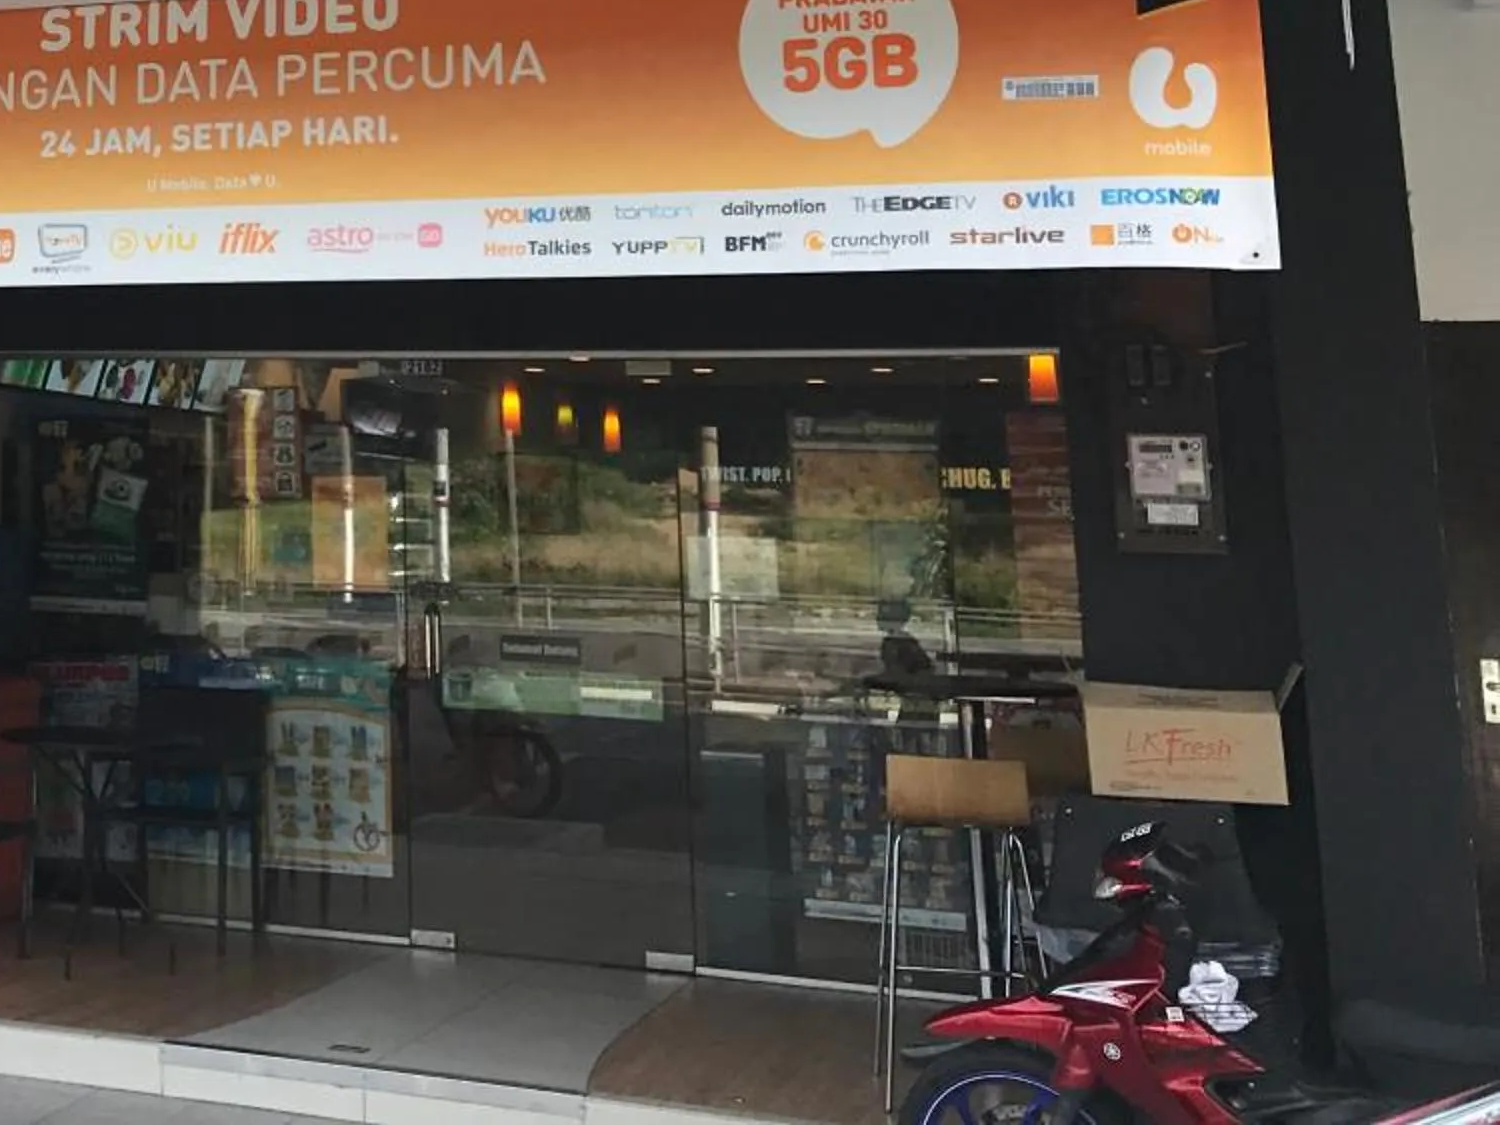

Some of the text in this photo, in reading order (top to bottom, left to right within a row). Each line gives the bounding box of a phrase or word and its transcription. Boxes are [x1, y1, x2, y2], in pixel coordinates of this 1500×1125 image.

[802, 8, 889, 34] UMI 30
[136, 57, 259, 105] DATA
[277, 39, 548, 97] PERCUMA
[781, 33, 920, 94] 5GB
[39, 114, 399, 159] 24 JAM, SETIAP HARI.
[1143, 137, 1213, 157] mobile
[721, 198, 827, 221] dailymotion
[219, 221, 280, 255] iflix
[306, 224, 374, 247] astro
[830, 230, 931, 250] crunchyroll
[949, 226, 1066, 245] starlive
[941, 466, 997, 490] HUG.
